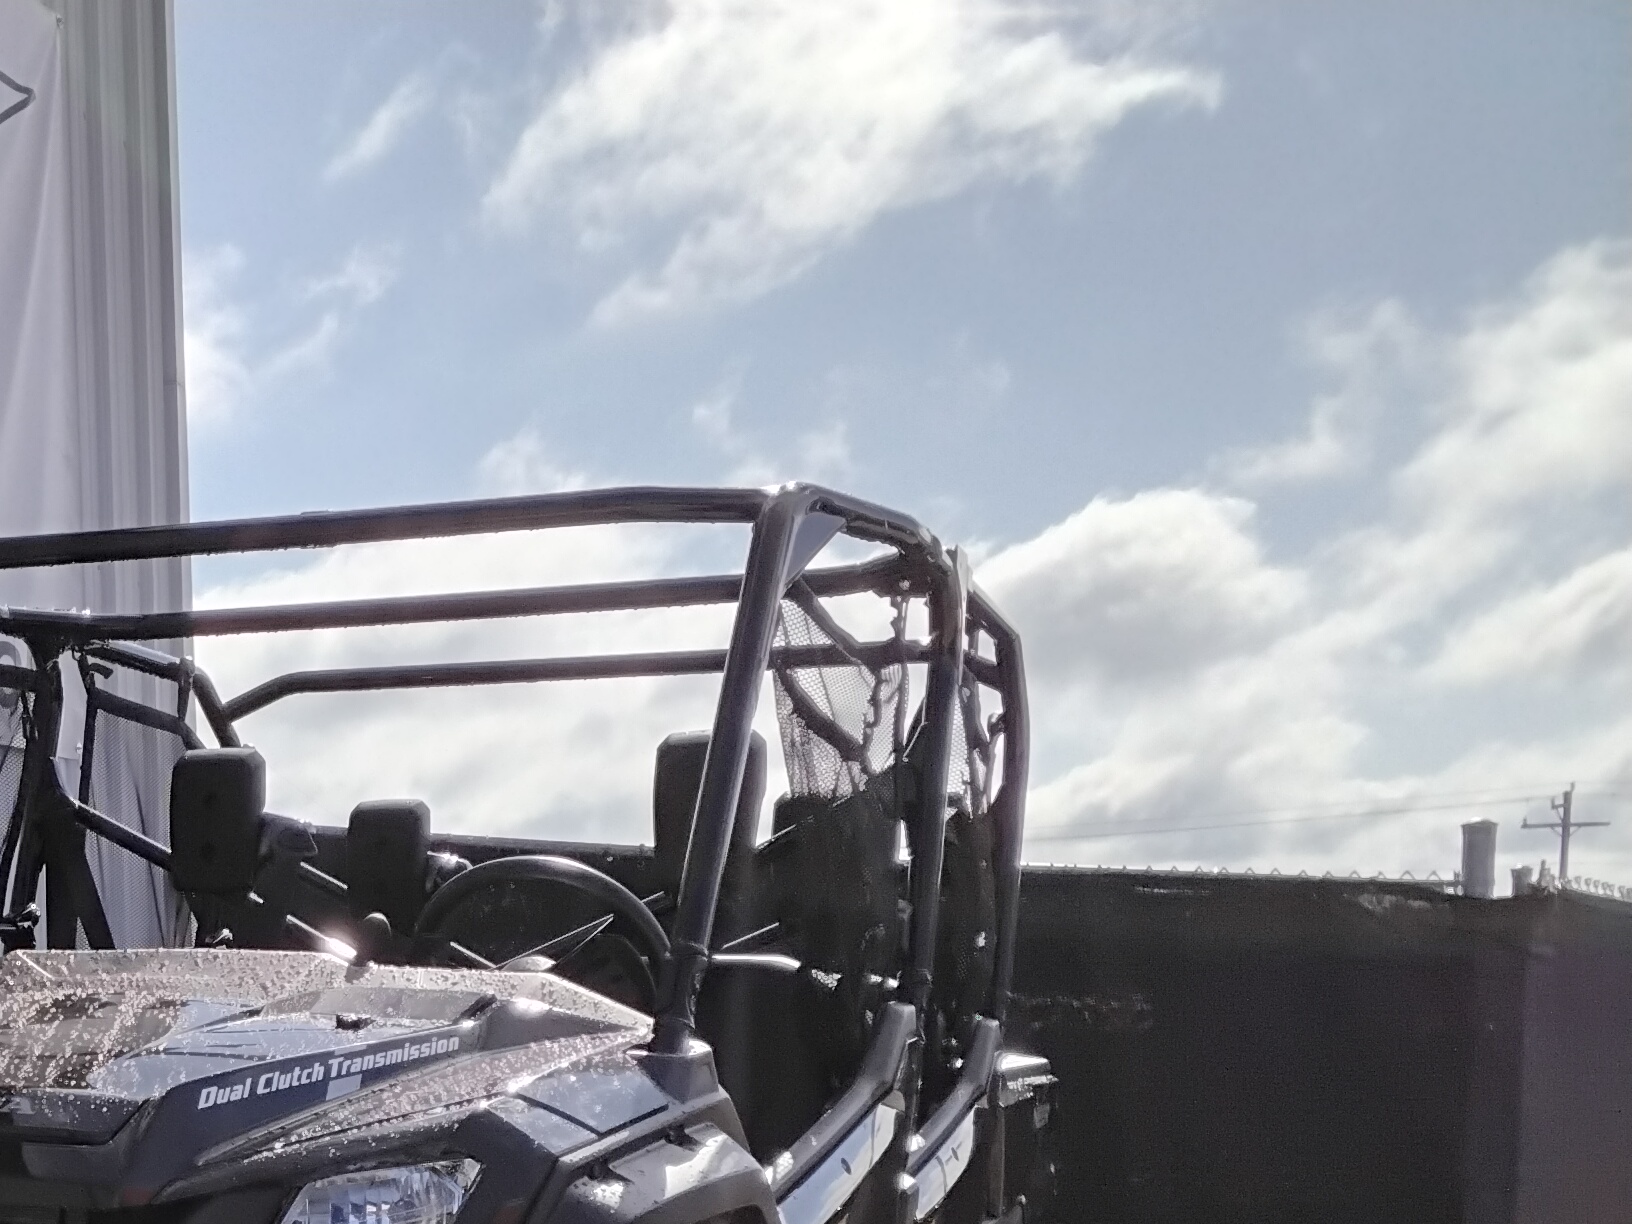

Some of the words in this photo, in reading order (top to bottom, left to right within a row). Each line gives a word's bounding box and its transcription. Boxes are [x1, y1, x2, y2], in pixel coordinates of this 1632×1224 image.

[197, 1077, 252, 1110] Dual
[256, 1061, 324, 1095] Clutch
[328, 1036, 460, 1079] Transmission
